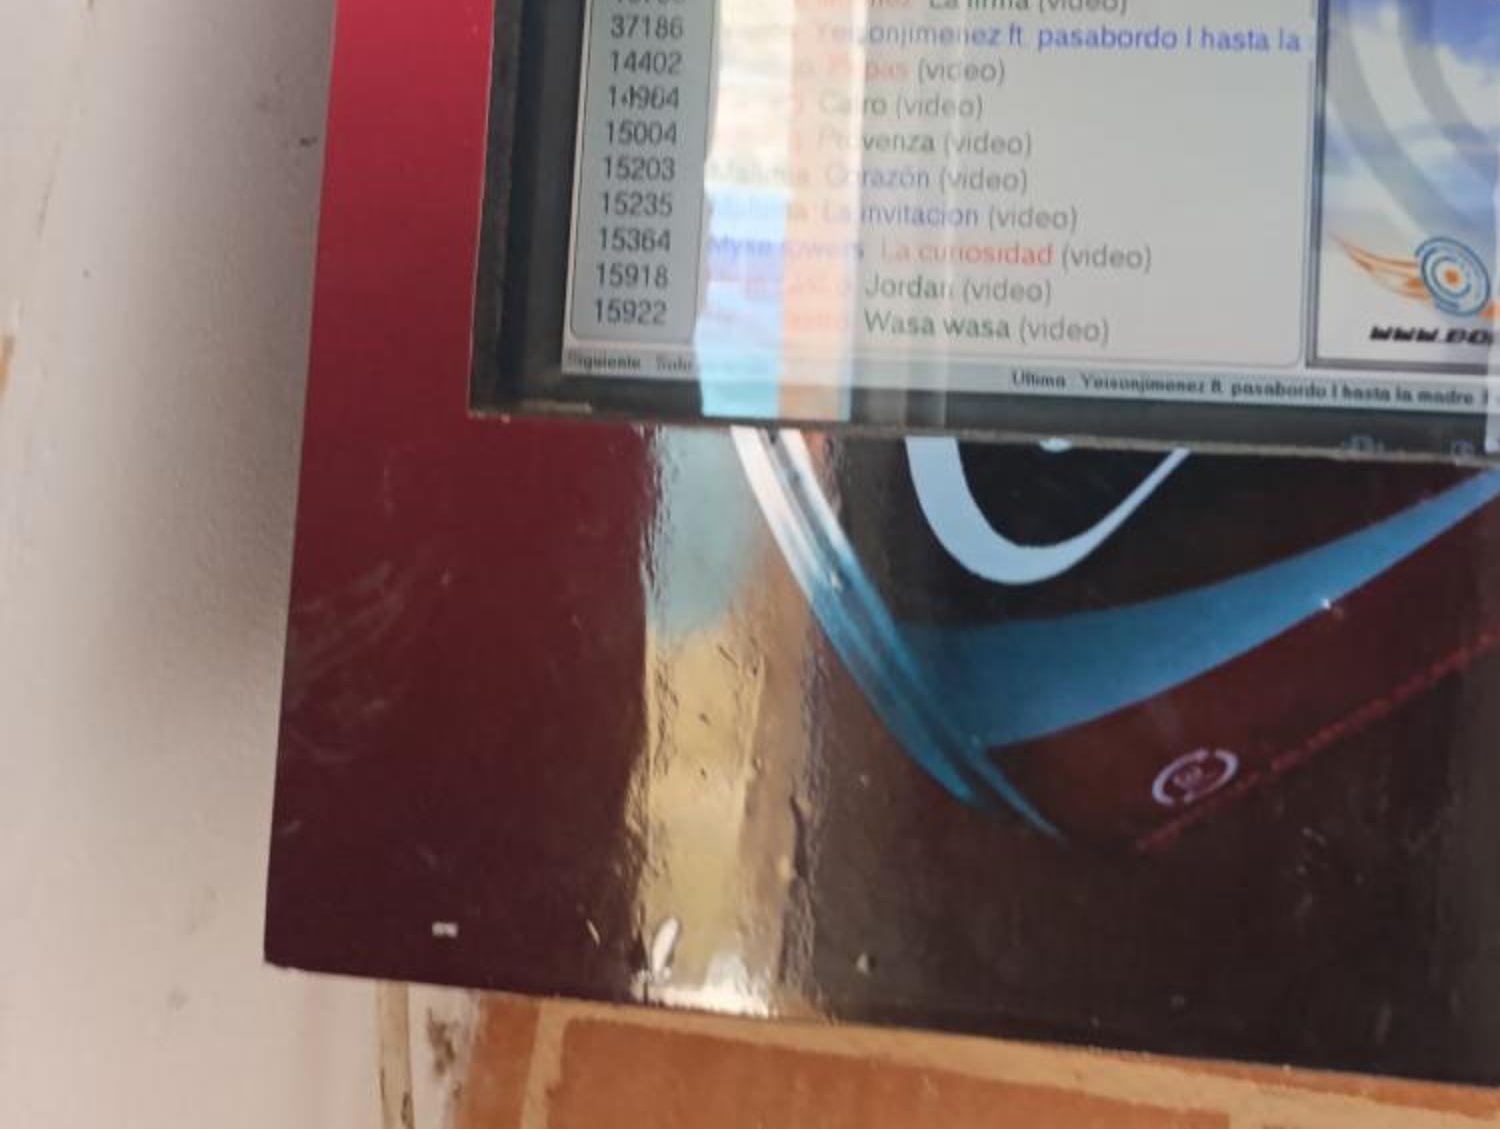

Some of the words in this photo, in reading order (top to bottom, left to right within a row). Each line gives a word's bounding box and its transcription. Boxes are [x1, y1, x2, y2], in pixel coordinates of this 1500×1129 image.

[608, 16, 684, 41] 37186
[1036, 25, 1179, 53] pasabordo
[1200, 27, 1271, 52] hasta
[1278, 27, 1302, 52] la
[608, 50, 684, 76] 14402
[895, 93, 984, 122] (video)
[604, 121, 679, 146] 15004
[943, 130, 1032, 160] (video)
[602, 157, 677, 183] 15203
[937, 167, 1029, 196] (video)
[600, 192, 674, 218] 15235
[987, 204, 1079, 234] (video)
[598, 227, 671, 254] 15364
[1060, 245, 1153, 274] (video)
[595, 263, 669, 290] 15918
[961, 278, 1054, 307] (video)
[592, 298, 668, 326] 15922
[863, 307, 936, 338] Wasa
[944, 318, 1012, 341] wasa
[1018, 317, 1111, 348] (video)
[1342, 382, 1391, 402] hasta
[1395, 384, 1414, 403] la
[1416, 385, 1475, 406] madre
